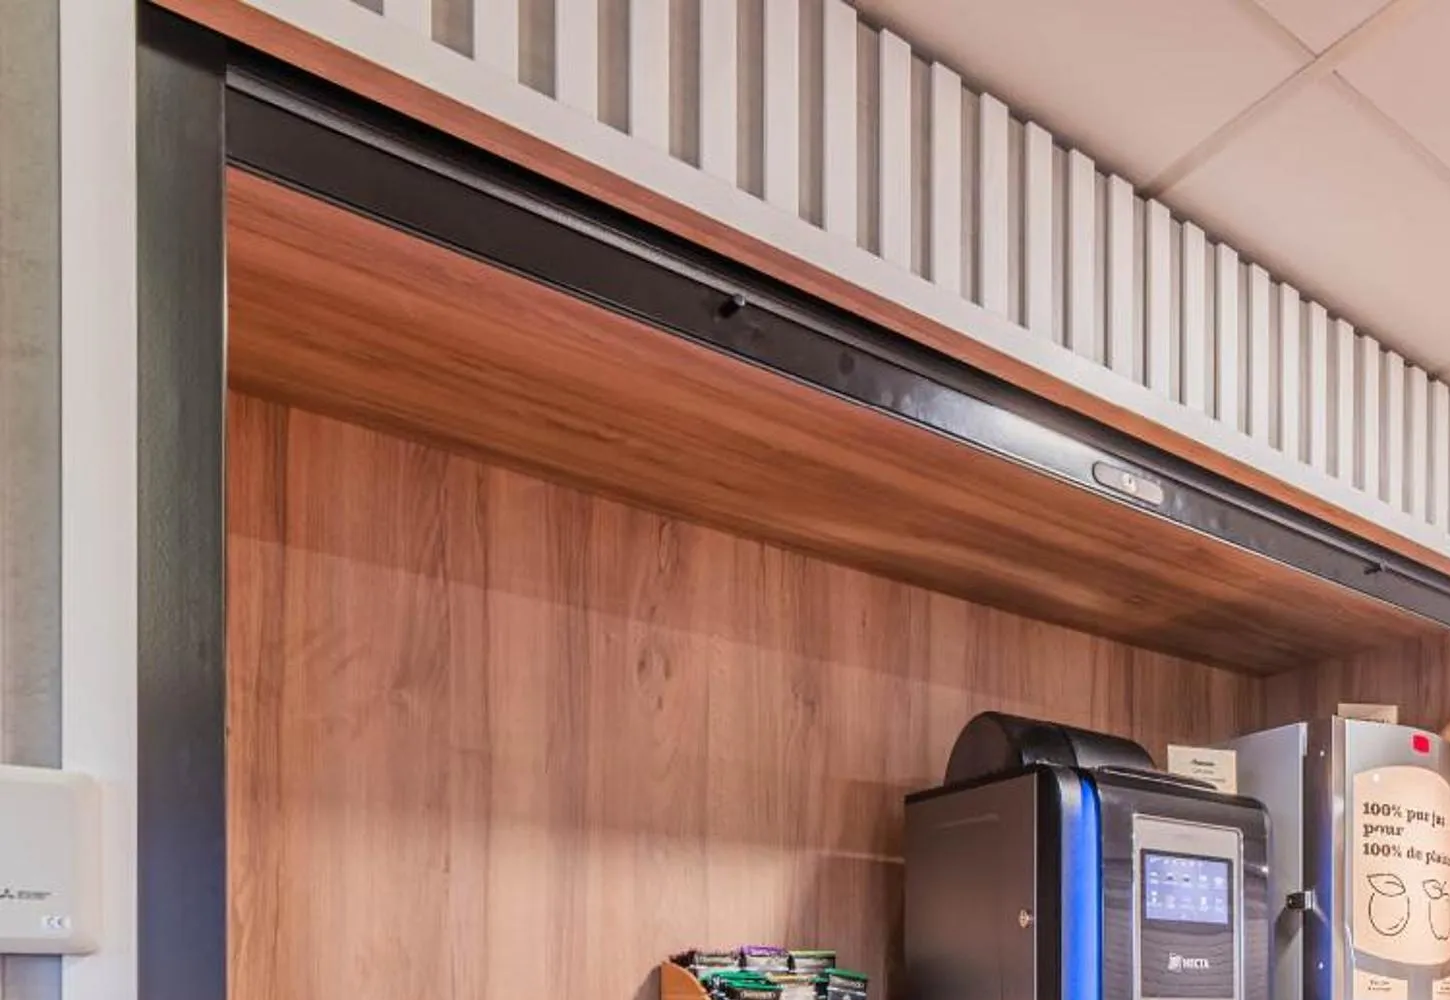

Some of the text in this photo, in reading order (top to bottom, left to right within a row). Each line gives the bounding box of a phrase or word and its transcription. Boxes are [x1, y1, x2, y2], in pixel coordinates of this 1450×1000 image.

[1362, 802, 1402, 818] 100%
[1406, 808, 1430, 823] pur
[1362, 823, 1405, 837] pour
[1362, 842, 1402, 858] 100%
[1406, 847, 1422, 860] de
